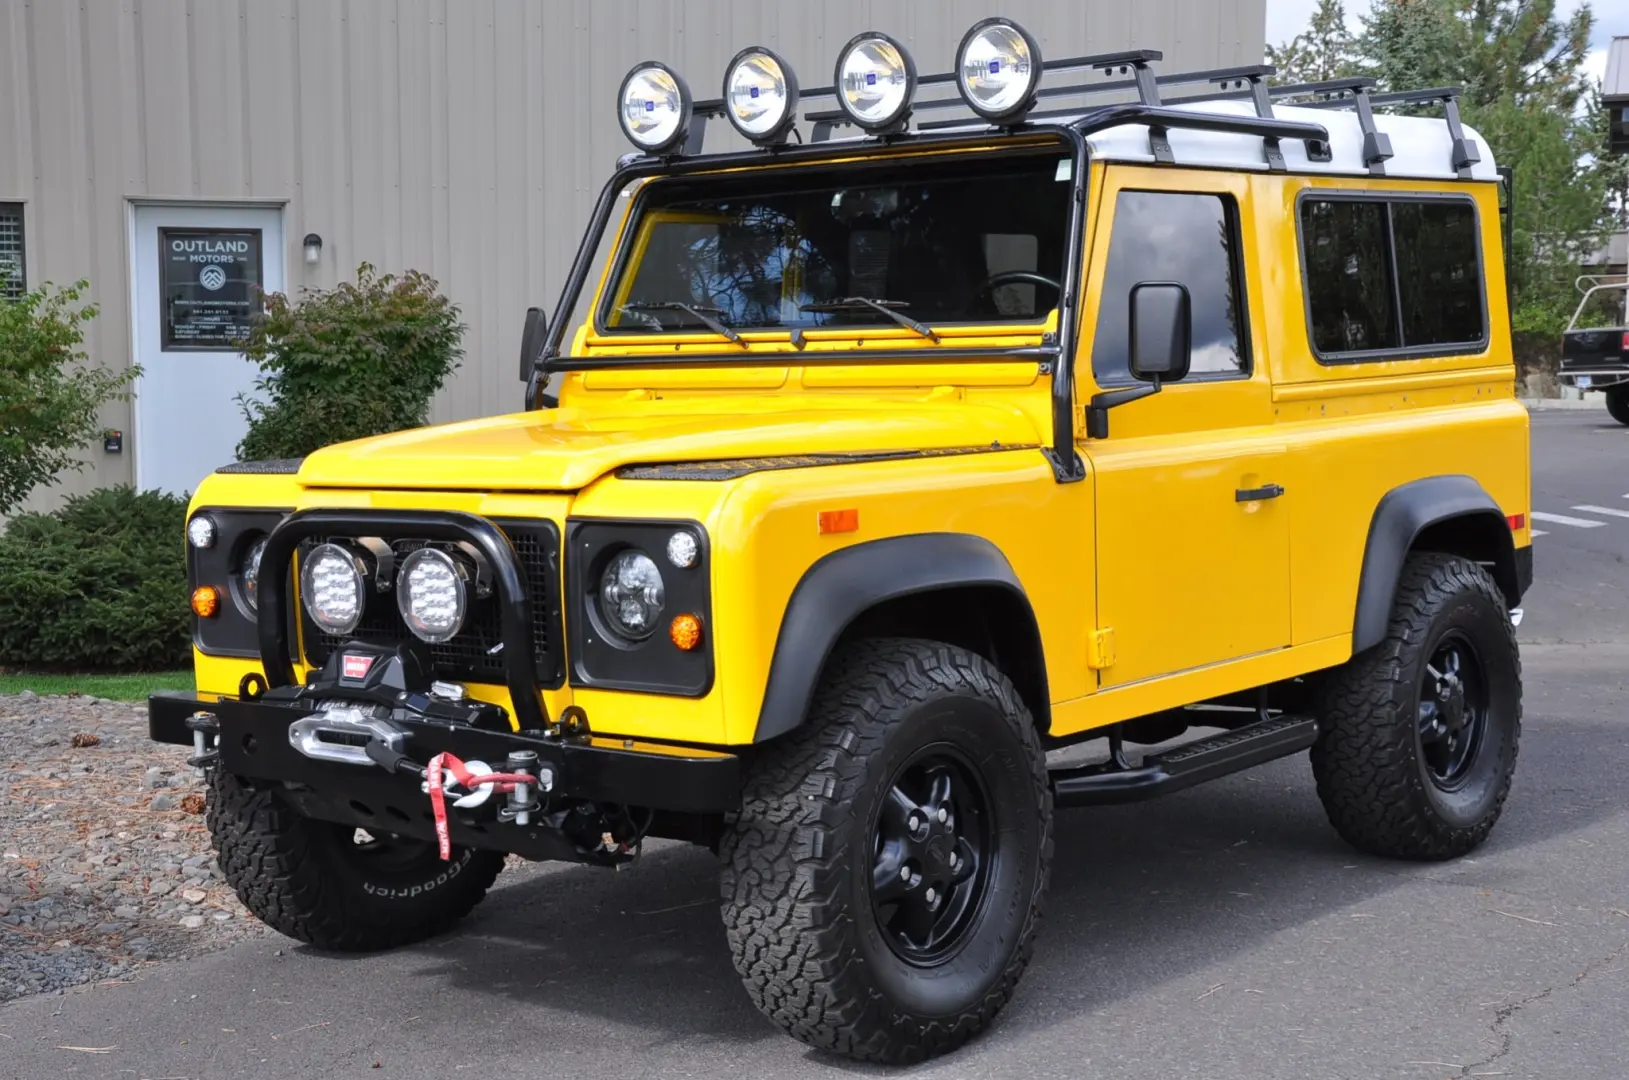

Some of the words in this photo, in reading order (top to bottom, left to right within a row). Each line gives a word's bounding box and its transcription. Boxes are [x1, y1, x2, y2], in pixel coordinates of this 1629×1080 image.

[172, 240, 249, 253] OUTLAND
[190, 254, 234, 264] MOTORS
[436, 821, 449, 854] WARN
[364, 848, 475, 898] FGoodrich
